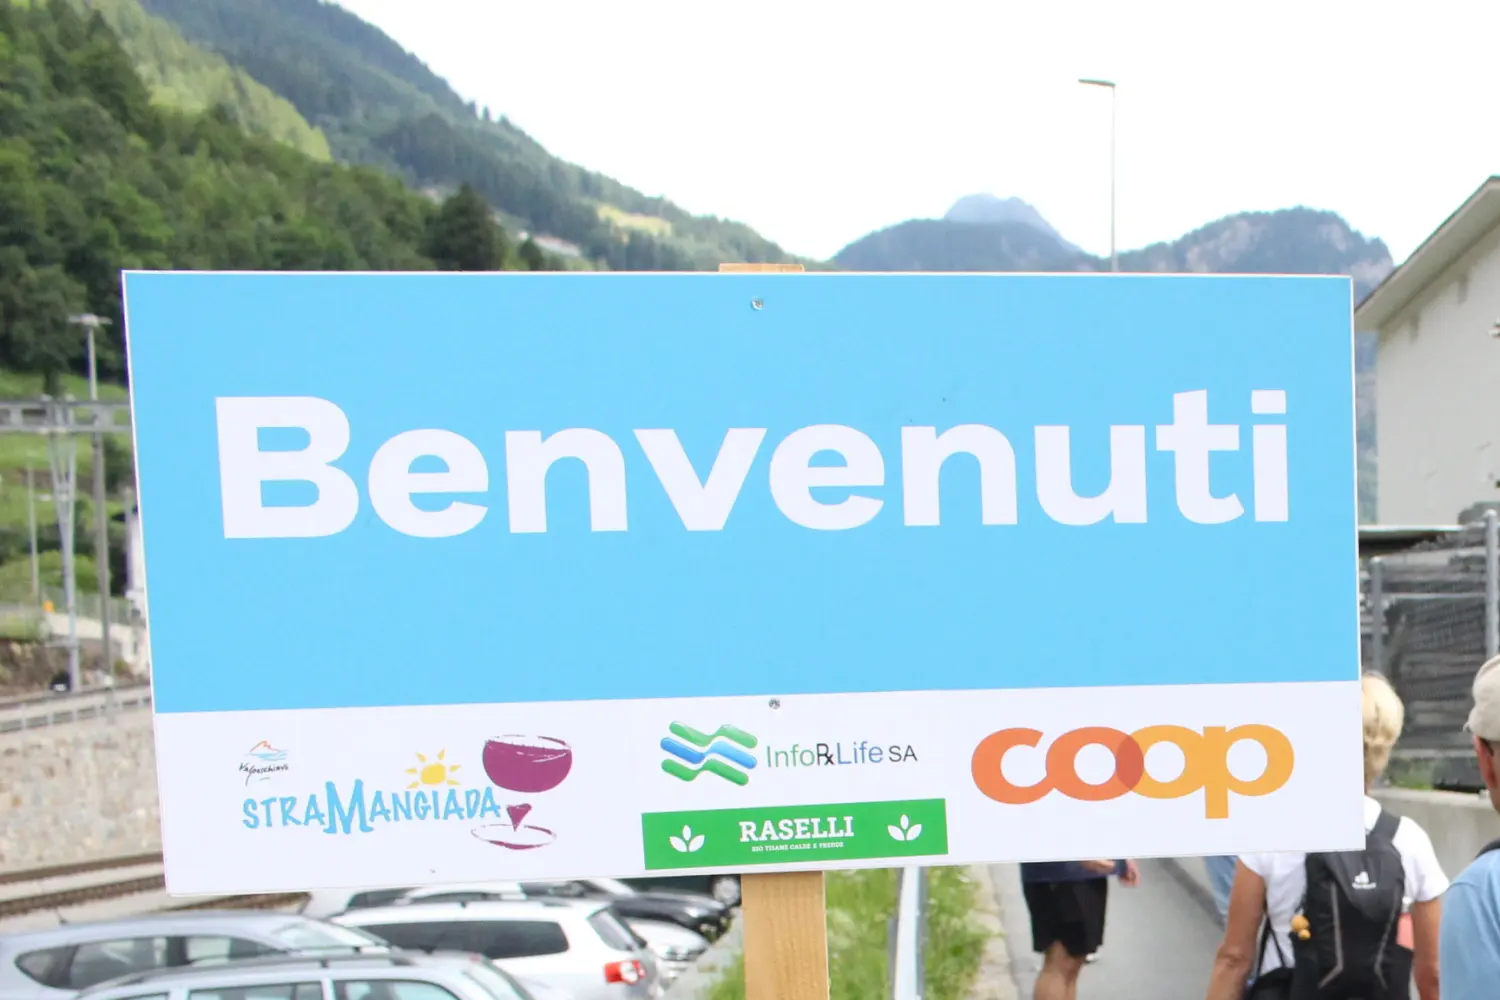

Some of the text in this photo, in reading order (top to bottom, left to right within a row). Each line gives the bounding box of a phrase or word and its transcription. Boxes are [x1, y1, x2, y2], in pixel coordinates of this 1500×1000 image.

[215, 389, 1289, 539] Benvenuti
[888, 745, 918, 763] SA
[971, 723, 1295, 819] coop
[242, 779, 500, 834] STRAMANGIADA
[738, 815, 855, 843] RASELLI
